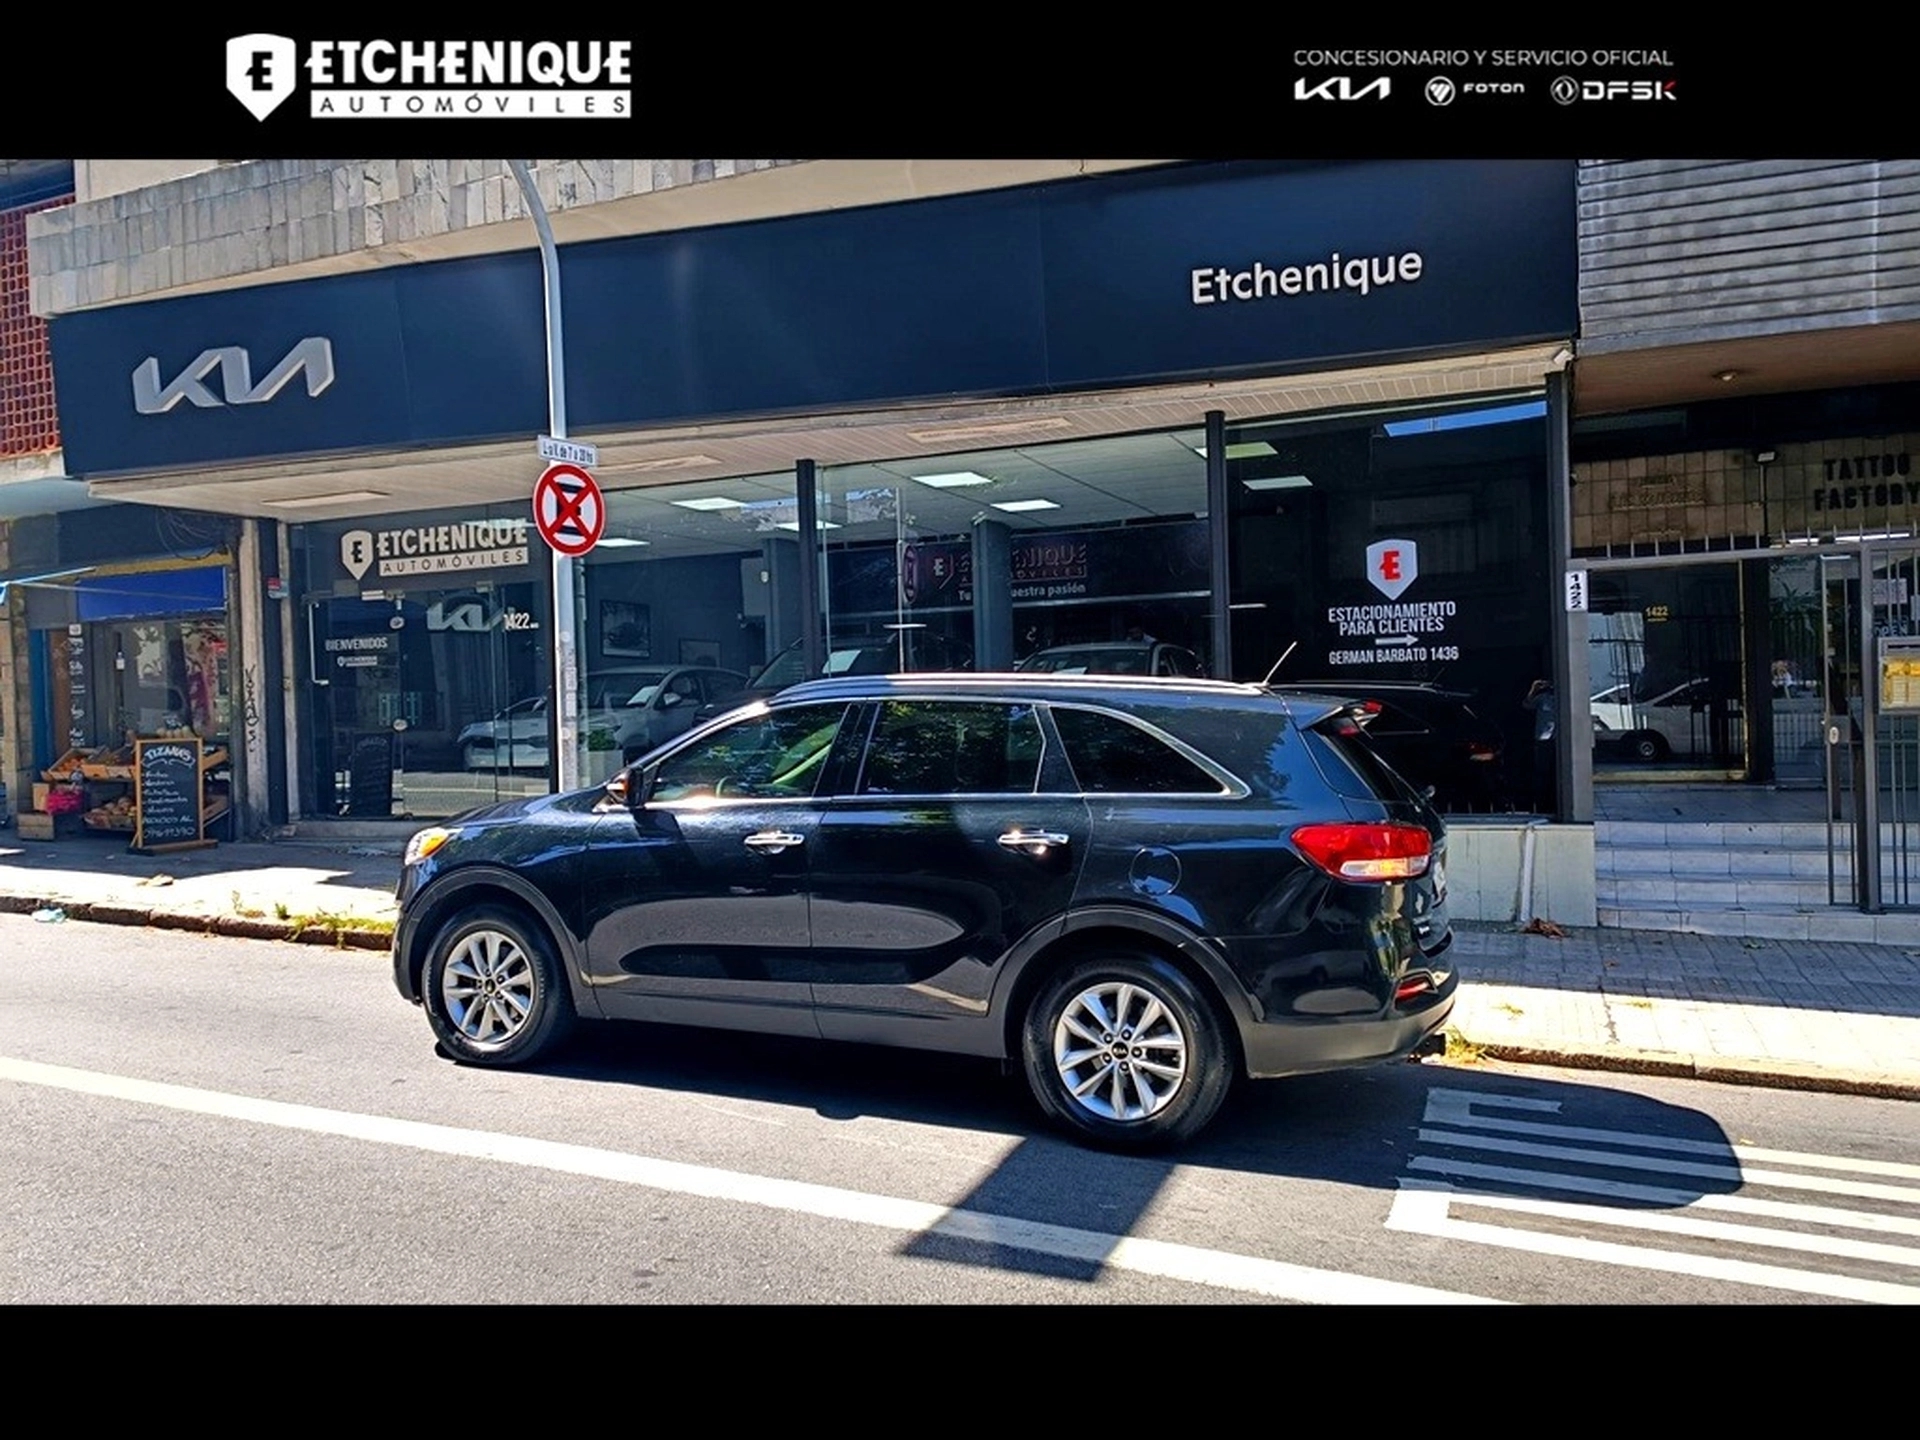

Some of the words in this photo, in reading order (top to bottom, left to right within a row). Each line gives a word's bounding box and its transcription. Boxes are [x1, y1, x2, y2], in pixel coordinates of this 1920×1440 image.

[1192, 252, 1422, 304] Etchenique
[132, 337, 335, 414] KIA
[1824, 453, 1911, 481] TATTOO
[1814, 482, 1920, 511] FACTORY
[377, 518, 528, 557] ETCHENIQUE
[384, 550, 523, 573] AUTOMÓVILES
[1011, 586, 1045, 598] uestra
[1048, 583, 1086, 597] pasión
[1570, 573, 1581, 608] 1422
[1328, 601, 1456, 622] ESTACIONAMIENTO
[1645, 605, 1668, 617] 1422
[1340, 620, 1375, 636] PARA
[1379, 616, 1445, 634] CLIENTES
[325, 637, 388, 650] BIENVENIDOS
[1329, 650, 1374, 665] GERMAN
[1376, 648, 1427, 663] BARBATO
[1431, 646, 1459, 661] 1436
